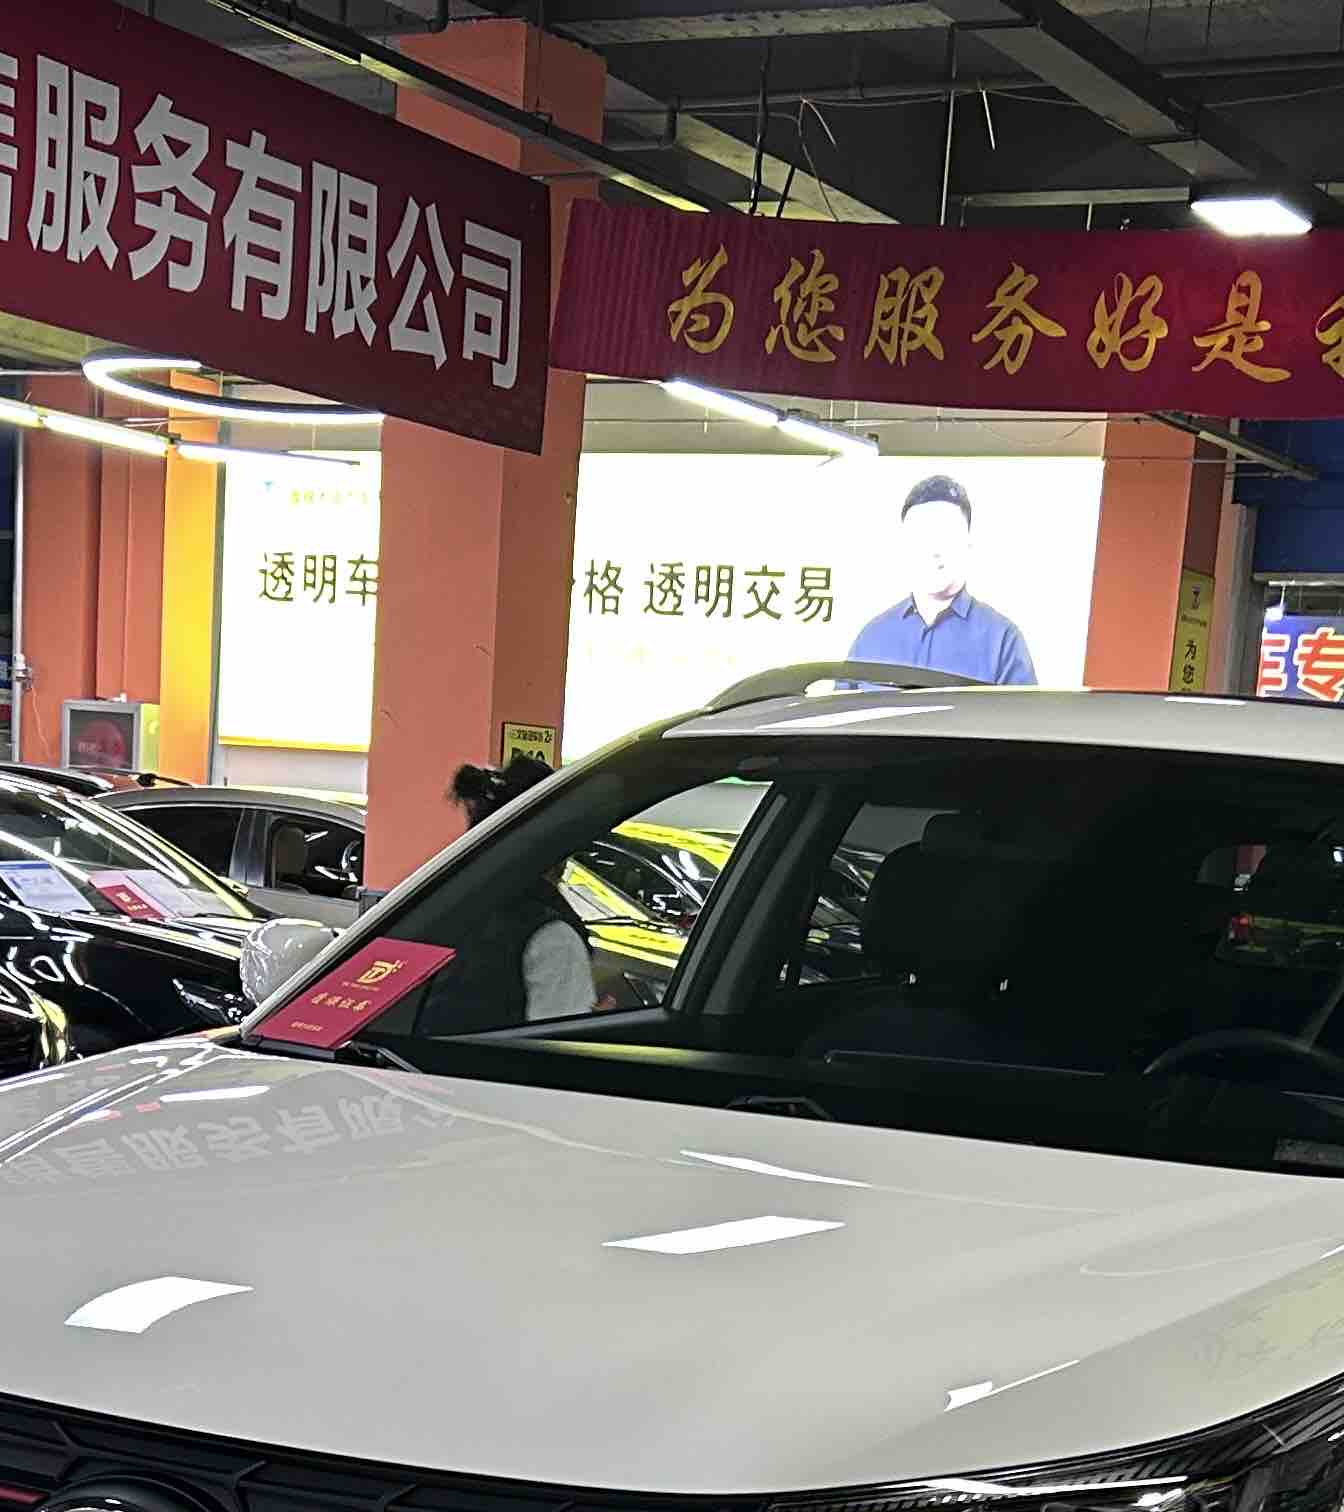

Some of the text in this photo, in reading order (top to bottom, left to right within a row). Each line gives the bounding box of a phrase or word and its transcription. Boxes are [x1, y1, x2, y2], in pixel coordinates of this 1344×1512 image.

[643, 561, 834, 622] 透明交易
[1180, 639, 1199, 692] 为您
